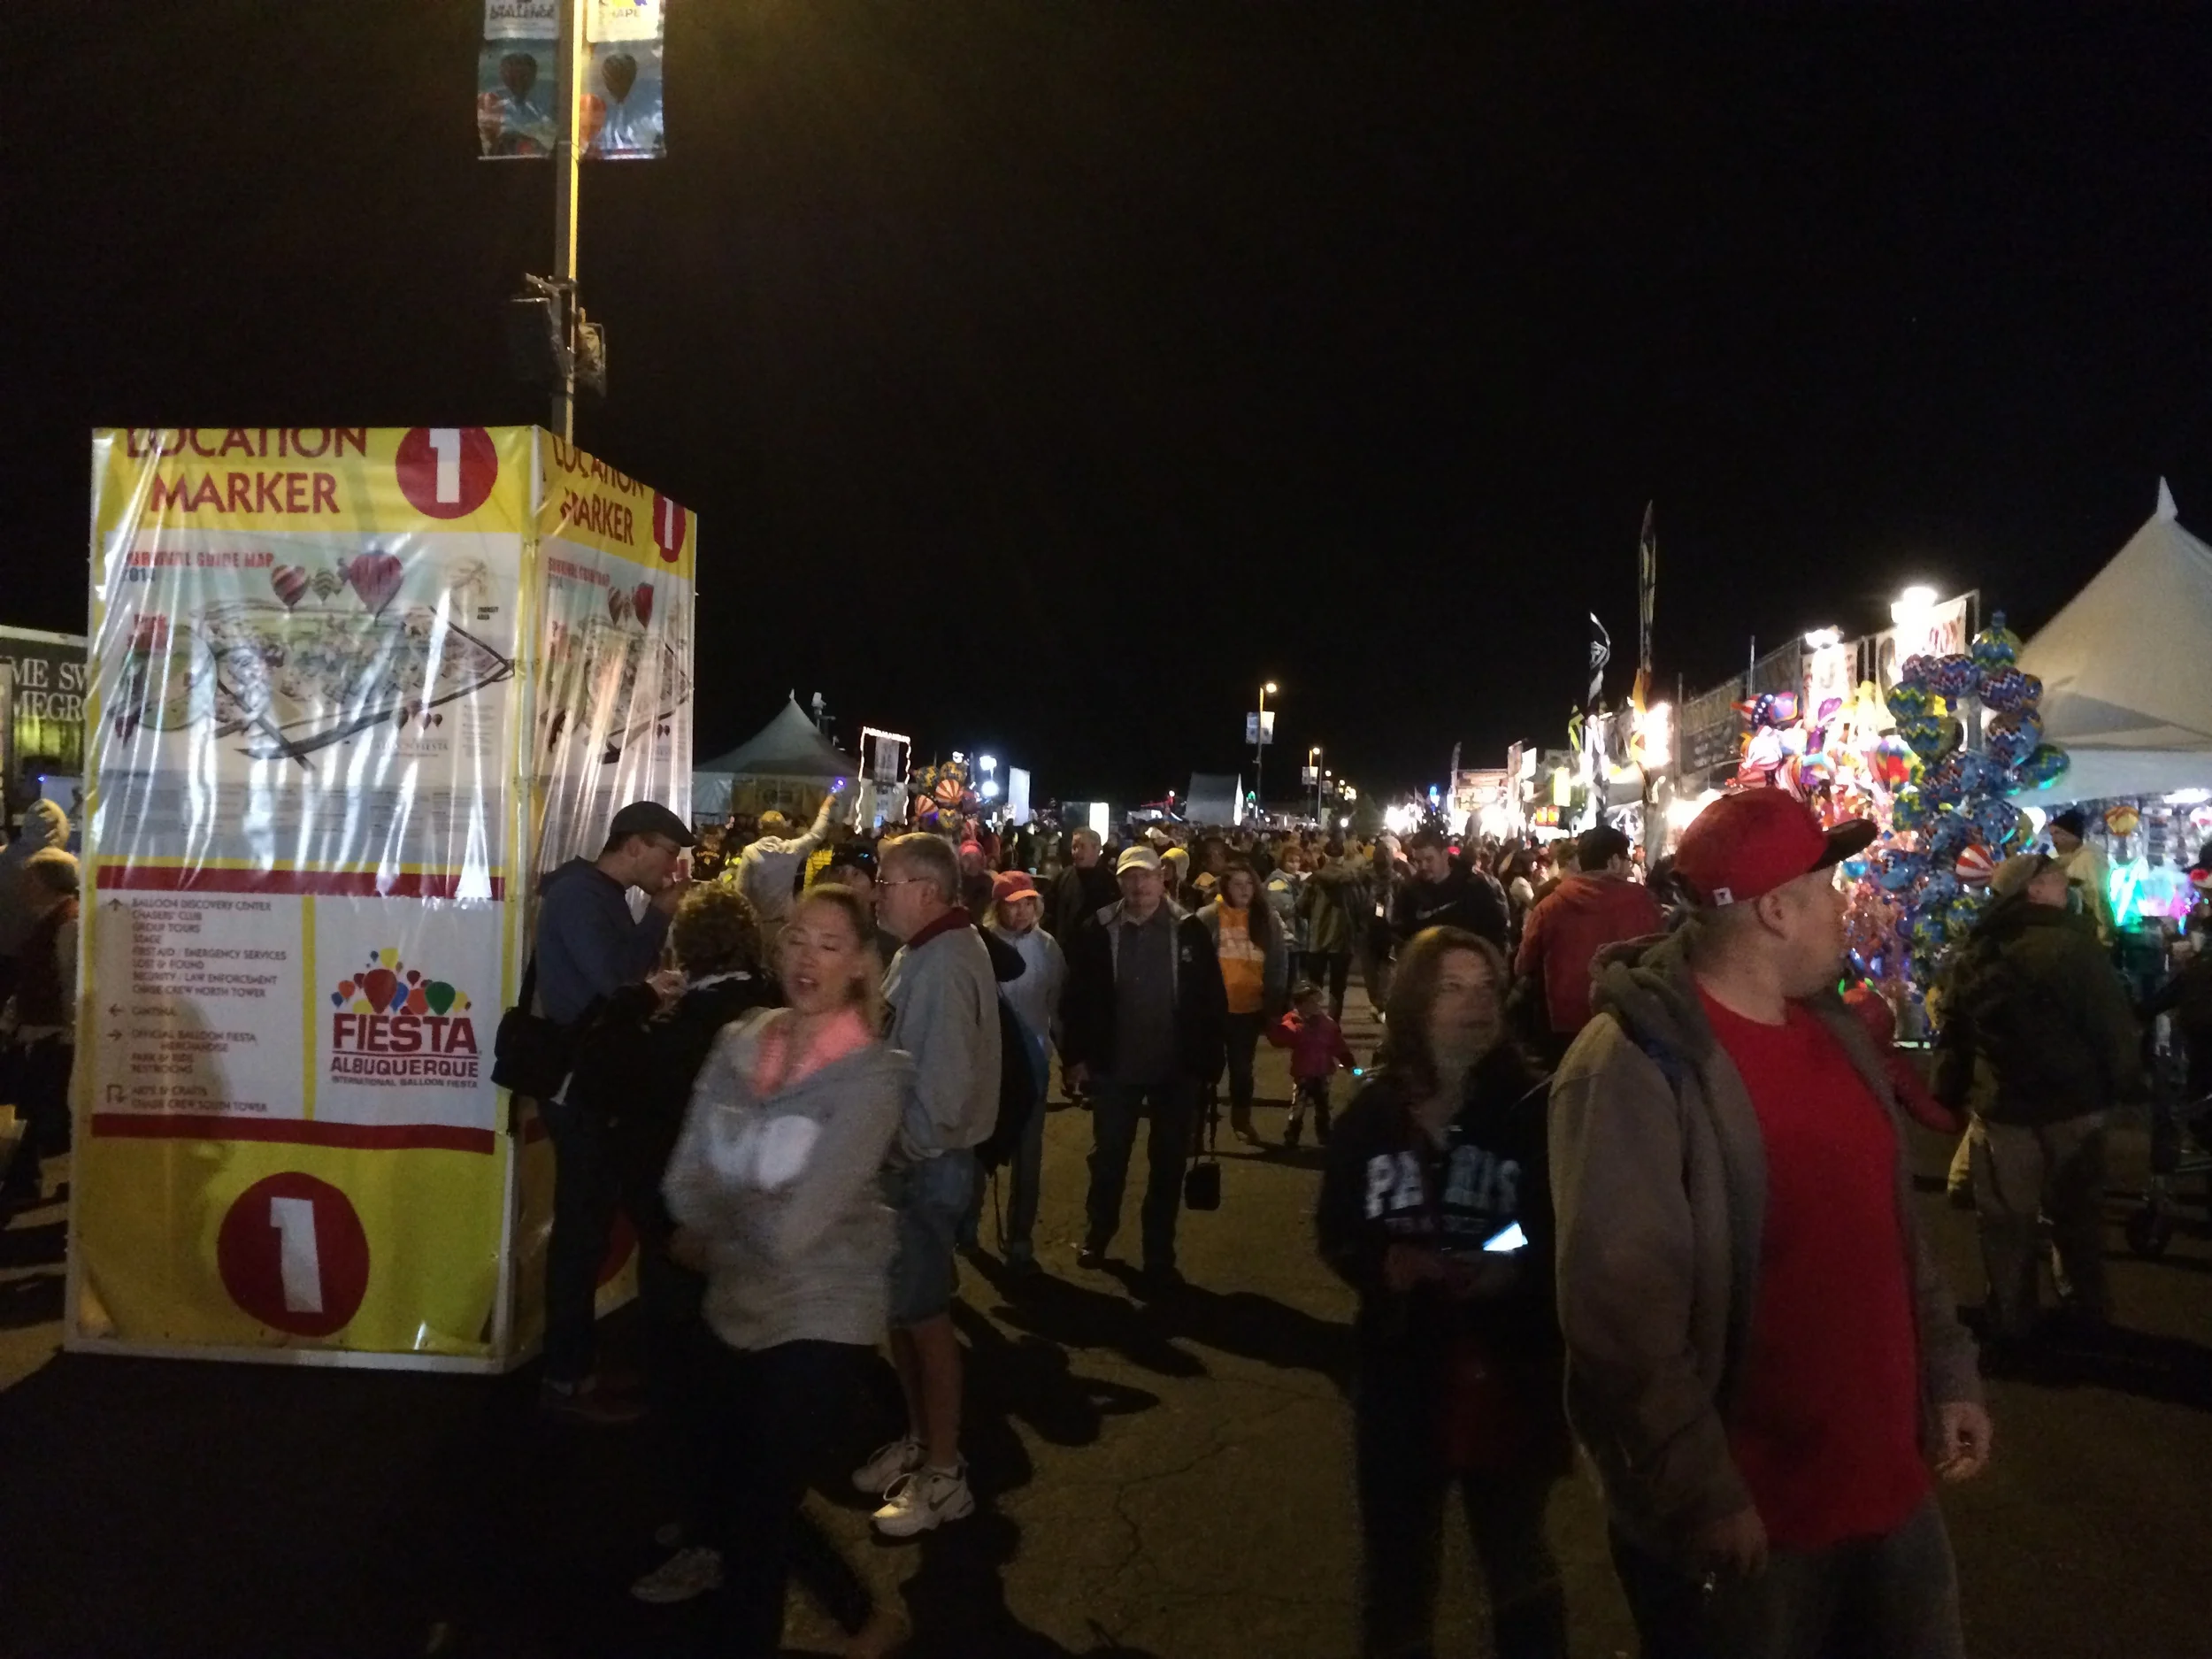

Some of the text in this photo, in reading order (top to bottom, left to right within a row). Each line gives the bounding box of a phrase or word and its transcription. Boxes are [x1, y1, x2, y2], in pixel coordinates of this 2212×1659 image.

[127, 428, 367, 458] LOCATION
[429, 429, 461, 504] 1
[150, 472, 340, 514] MARKER
[333, 1012, 478, 1055] FIESTA
[330, 1056, 479, 1078] ALBUQUERQUE
[270, 1196, 324, 1314] 1
